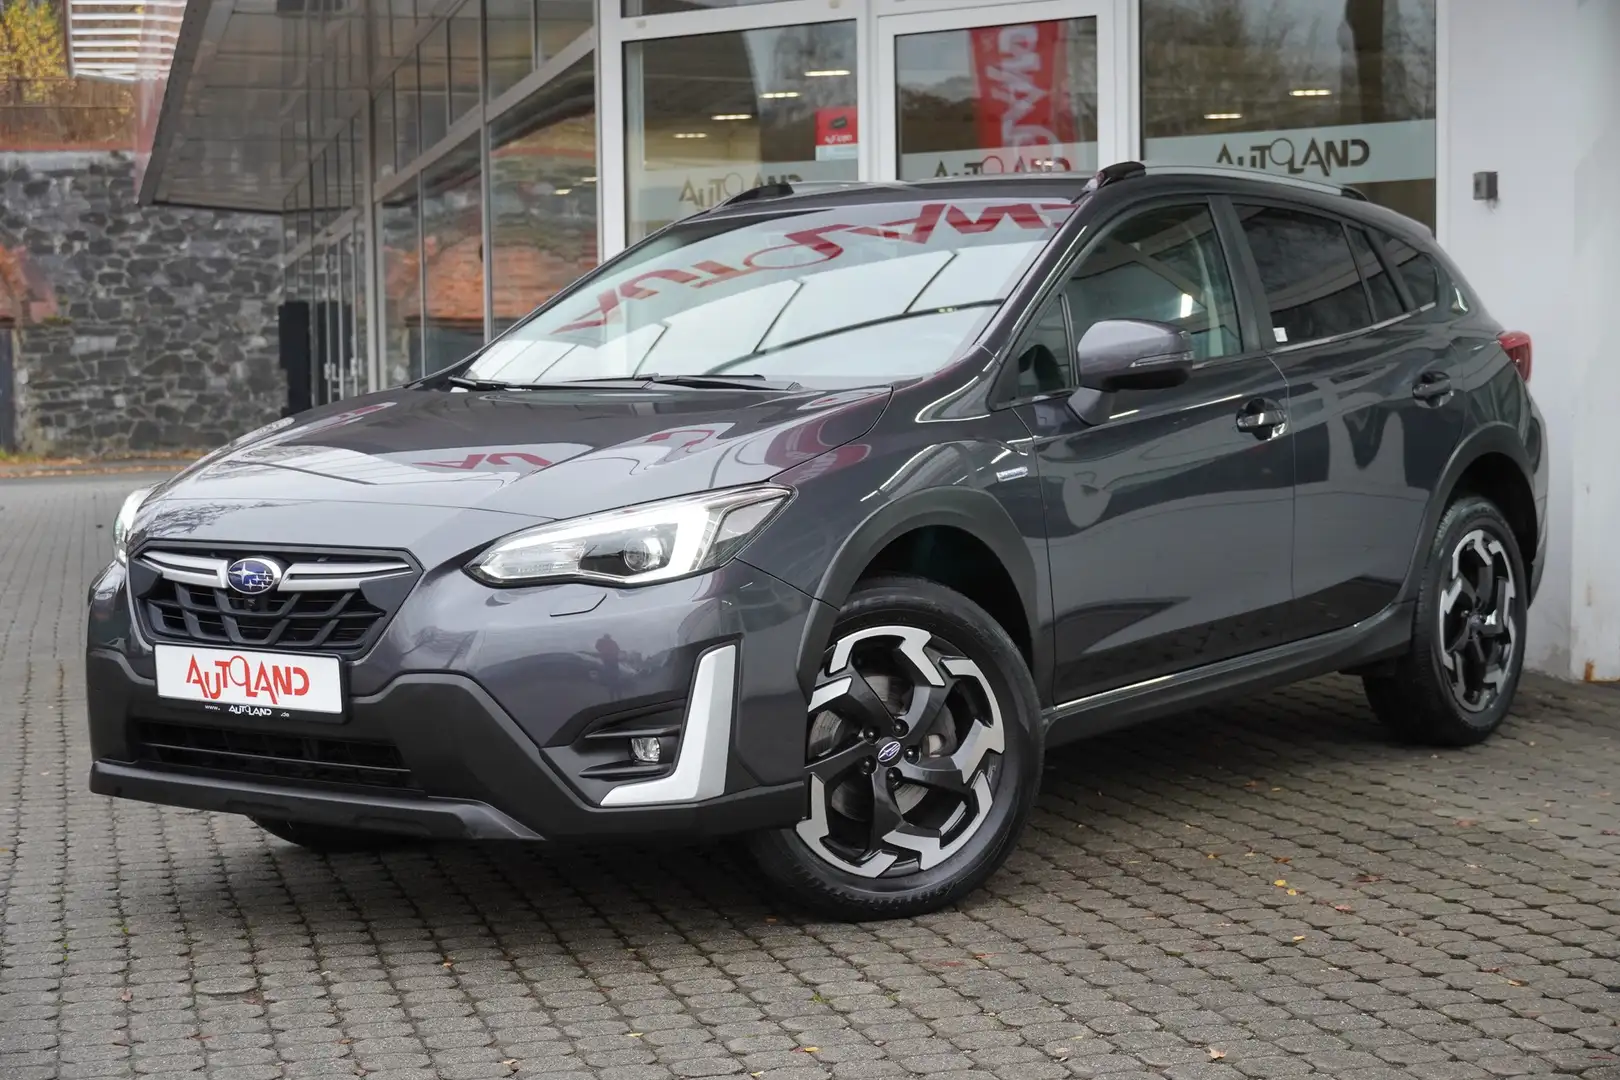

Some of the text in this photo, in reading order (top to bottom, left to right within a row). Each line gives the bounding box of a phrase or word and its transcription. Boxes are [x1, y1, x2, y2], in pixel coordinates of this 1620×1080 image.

[679, 172, 803, 210] AUTO
[186, 654, 310, 704] AUTOLAND
[229, 704, 272, 716] AUTOLAND
